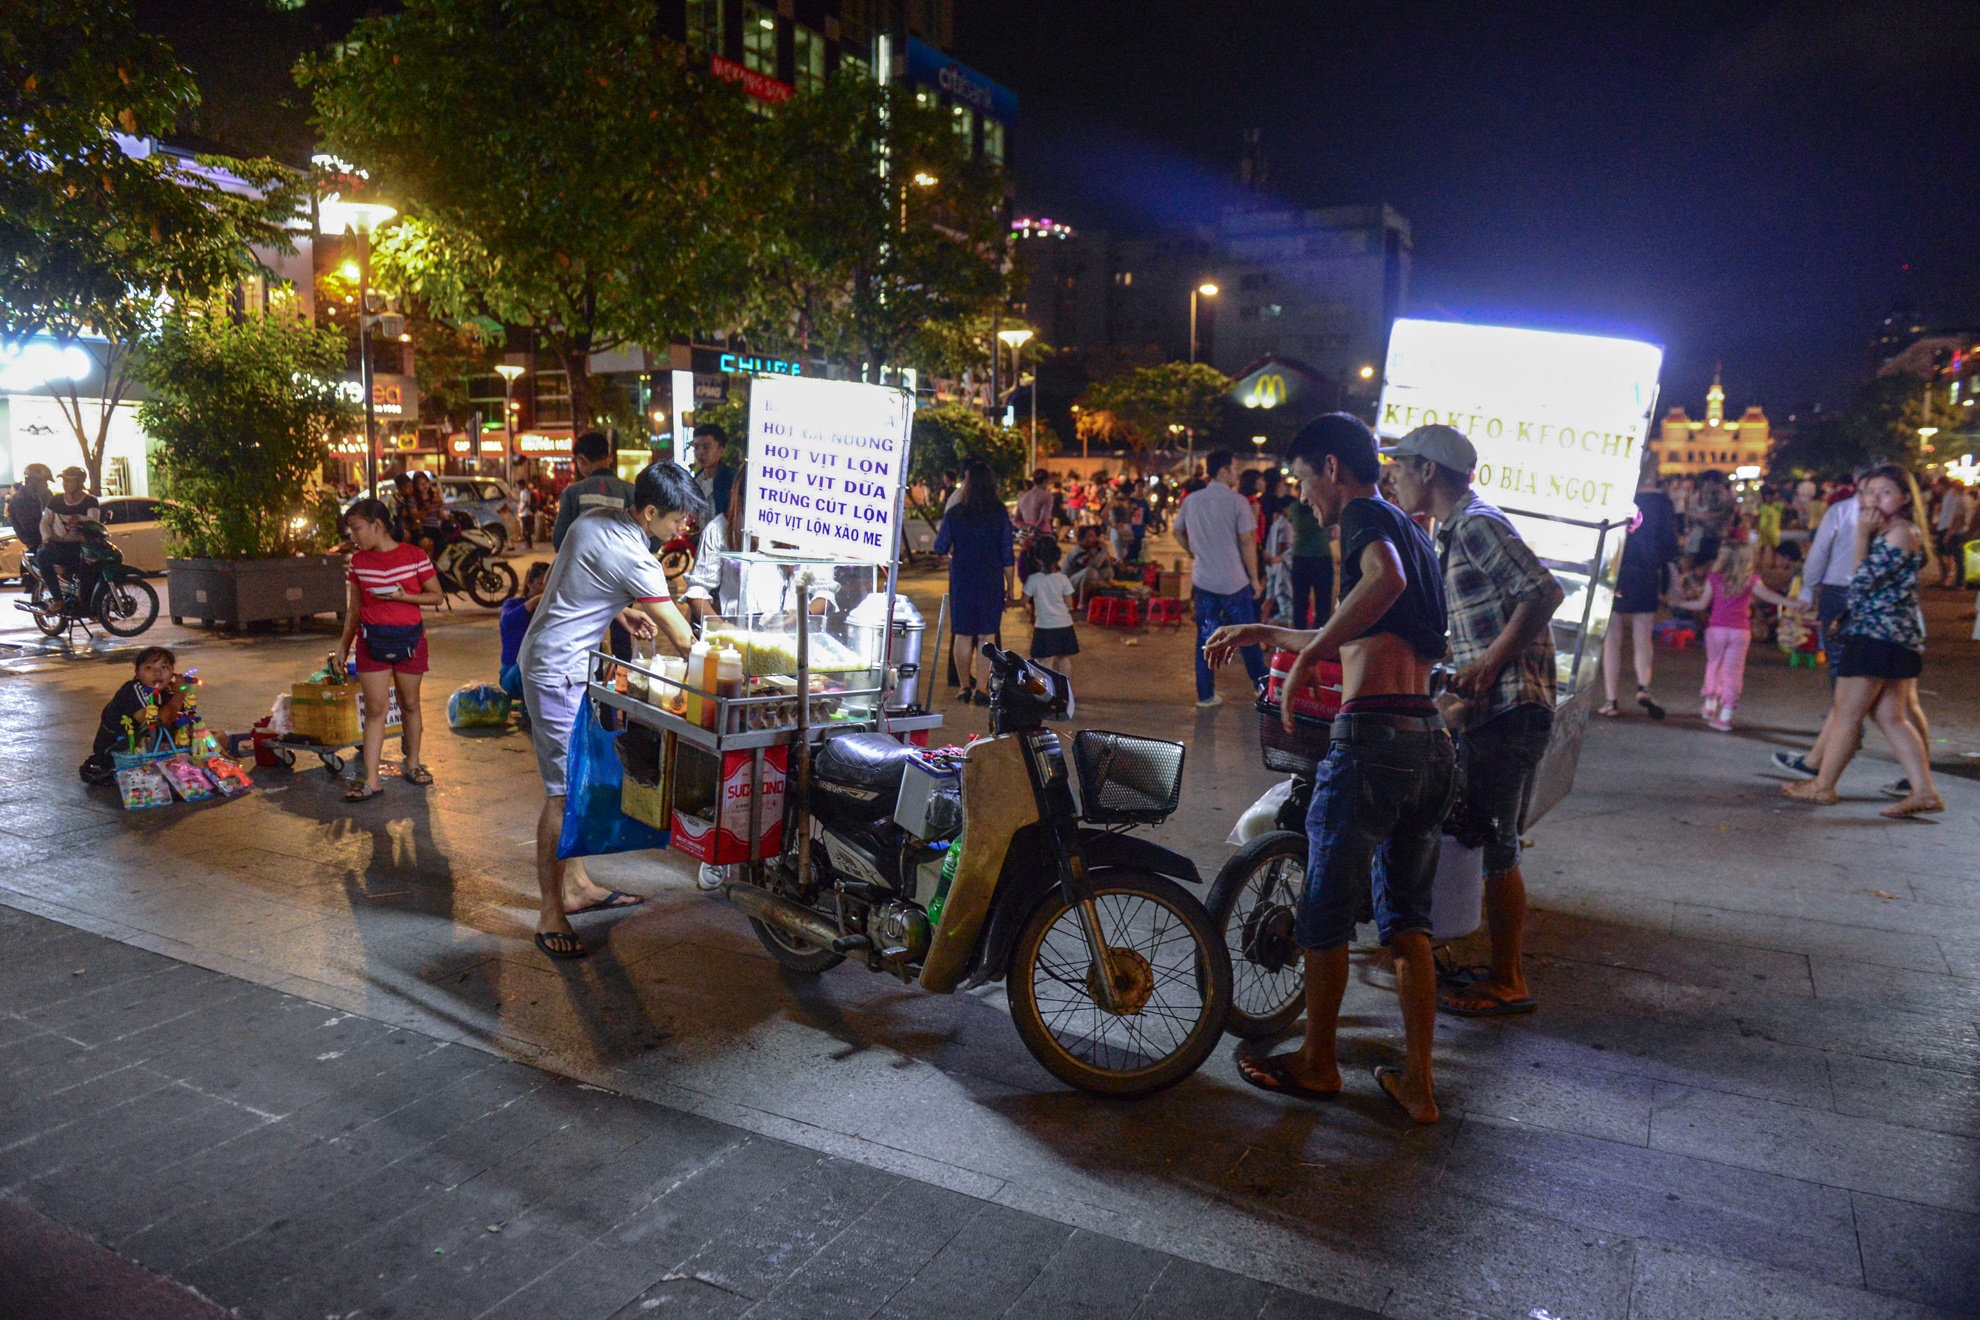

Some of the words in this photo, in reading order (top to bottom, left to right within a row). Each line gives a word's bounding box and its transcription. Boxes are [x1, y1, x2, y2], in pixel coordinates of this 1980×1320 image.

[810, 451, 839, 469] VỊT
[807, 473, 836, 491] VỊT
[758, 486, 810, 509] TRỨNG
[815, 497, 848, 516] CÚT
[853, 503, 888, 525] LỘN
[758, 507, 782, 526] HỘT
[785, 514, 803, 532] VỊT
[806, 517, 831, 536] LỘN
[834, 524, 860, 542] XÀO
[863, 531, 883, 548] ME
